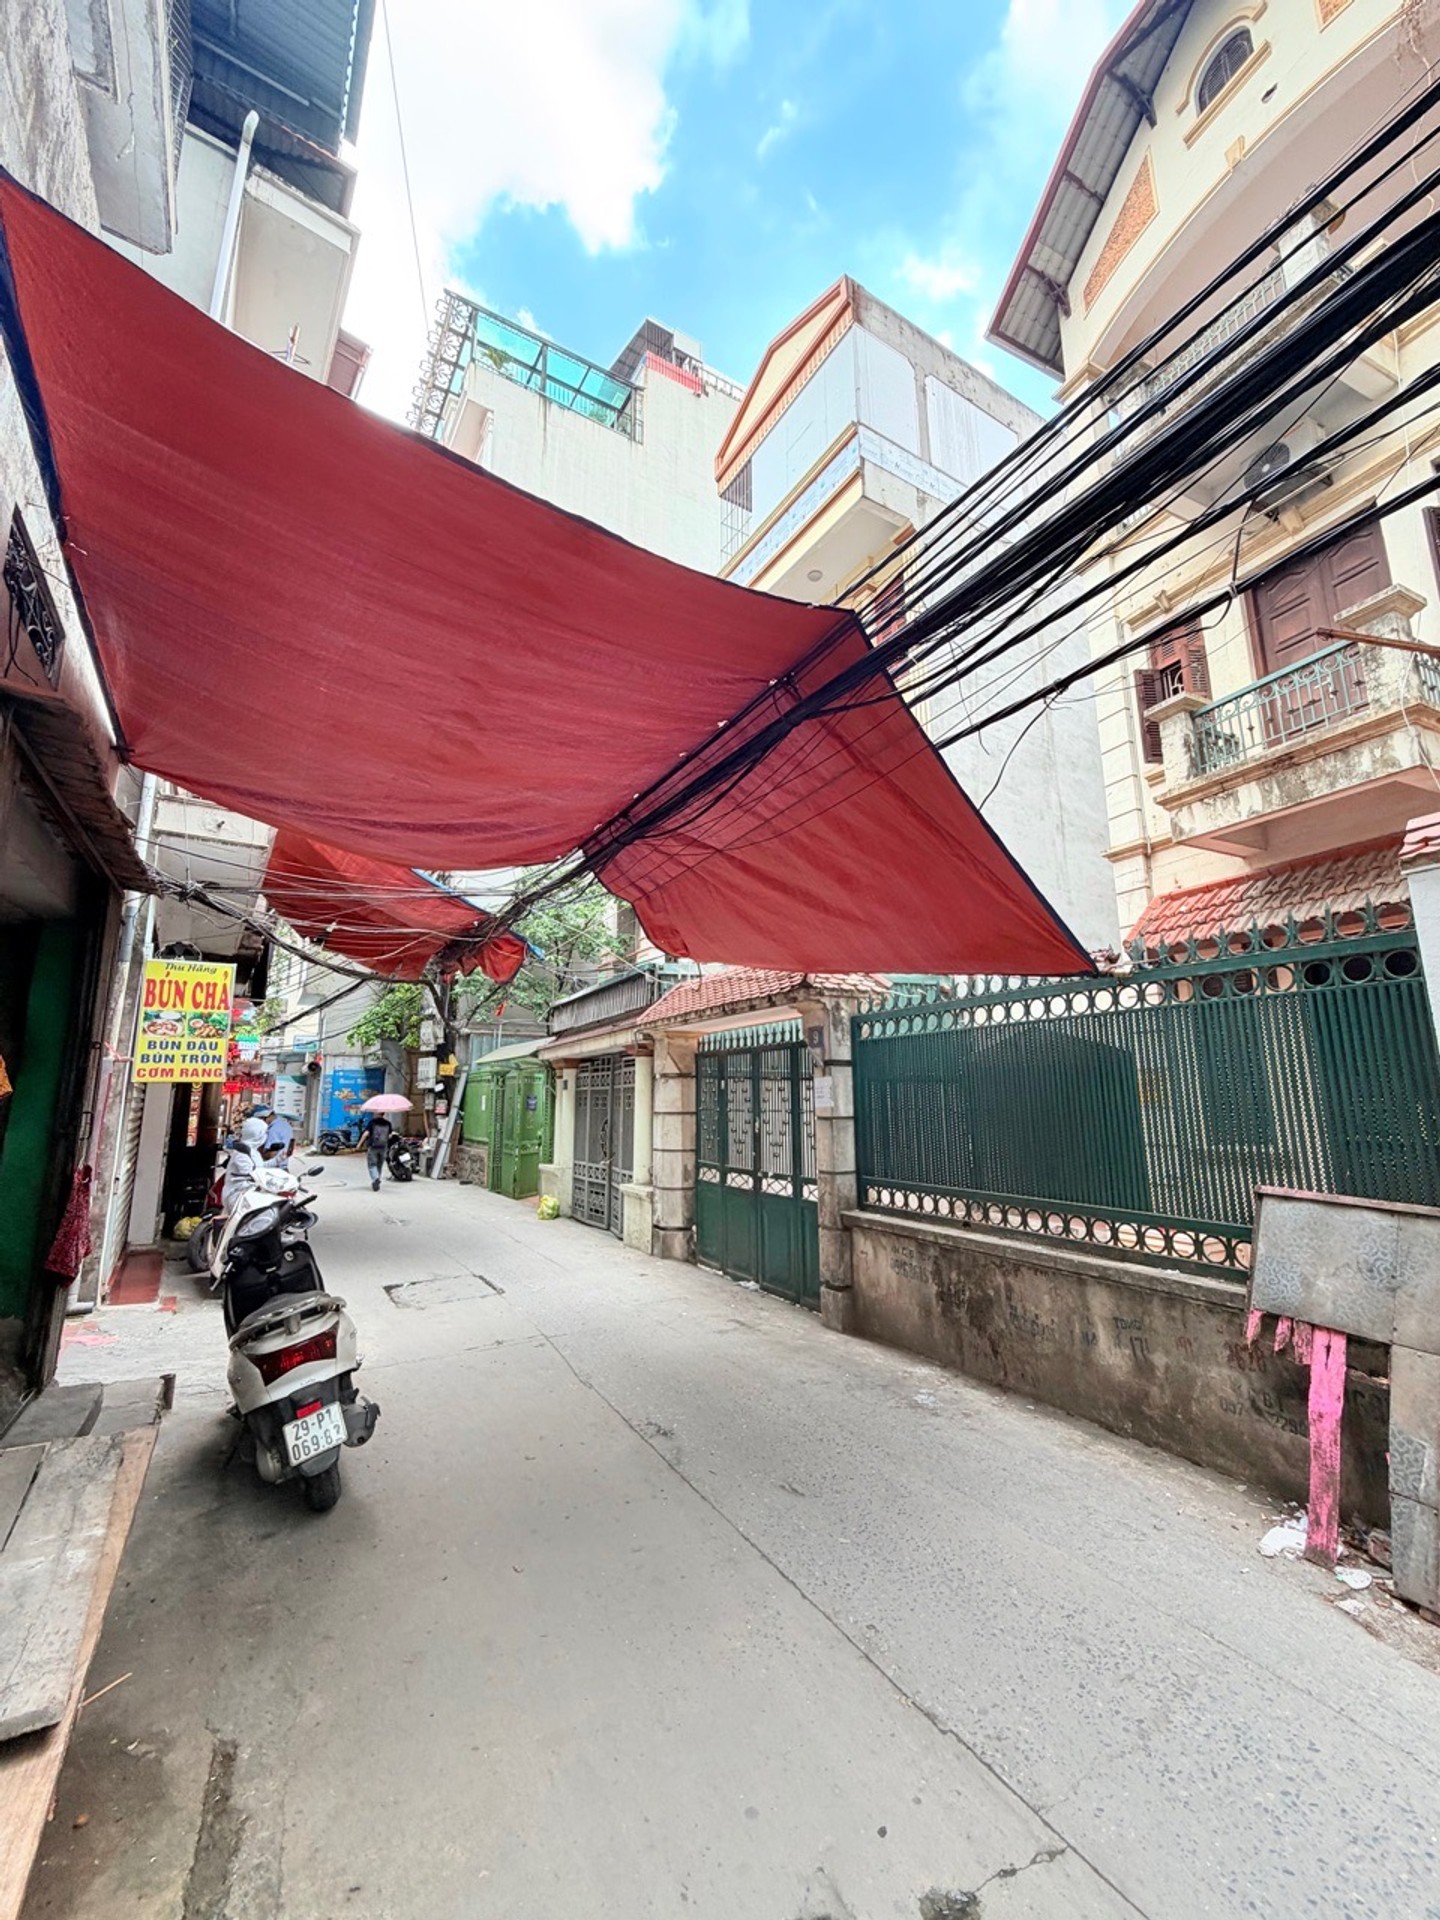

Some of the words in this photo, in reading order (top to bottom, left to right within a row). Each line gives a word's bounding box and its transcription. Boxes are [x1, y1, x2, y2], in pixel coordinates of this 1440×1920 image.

[143, 971, 187, 1008] BÚN
[191, 971, 231, 1010] CHẢ
[812, 1030, 820, 1044] 9
[147, 1038, 181, 1050] BÚN
[141, 1052, 175, 1064] BÚN
[136, 1067, 174, 1078] CƠM
[180, 1068, 223, 1078] RANG
